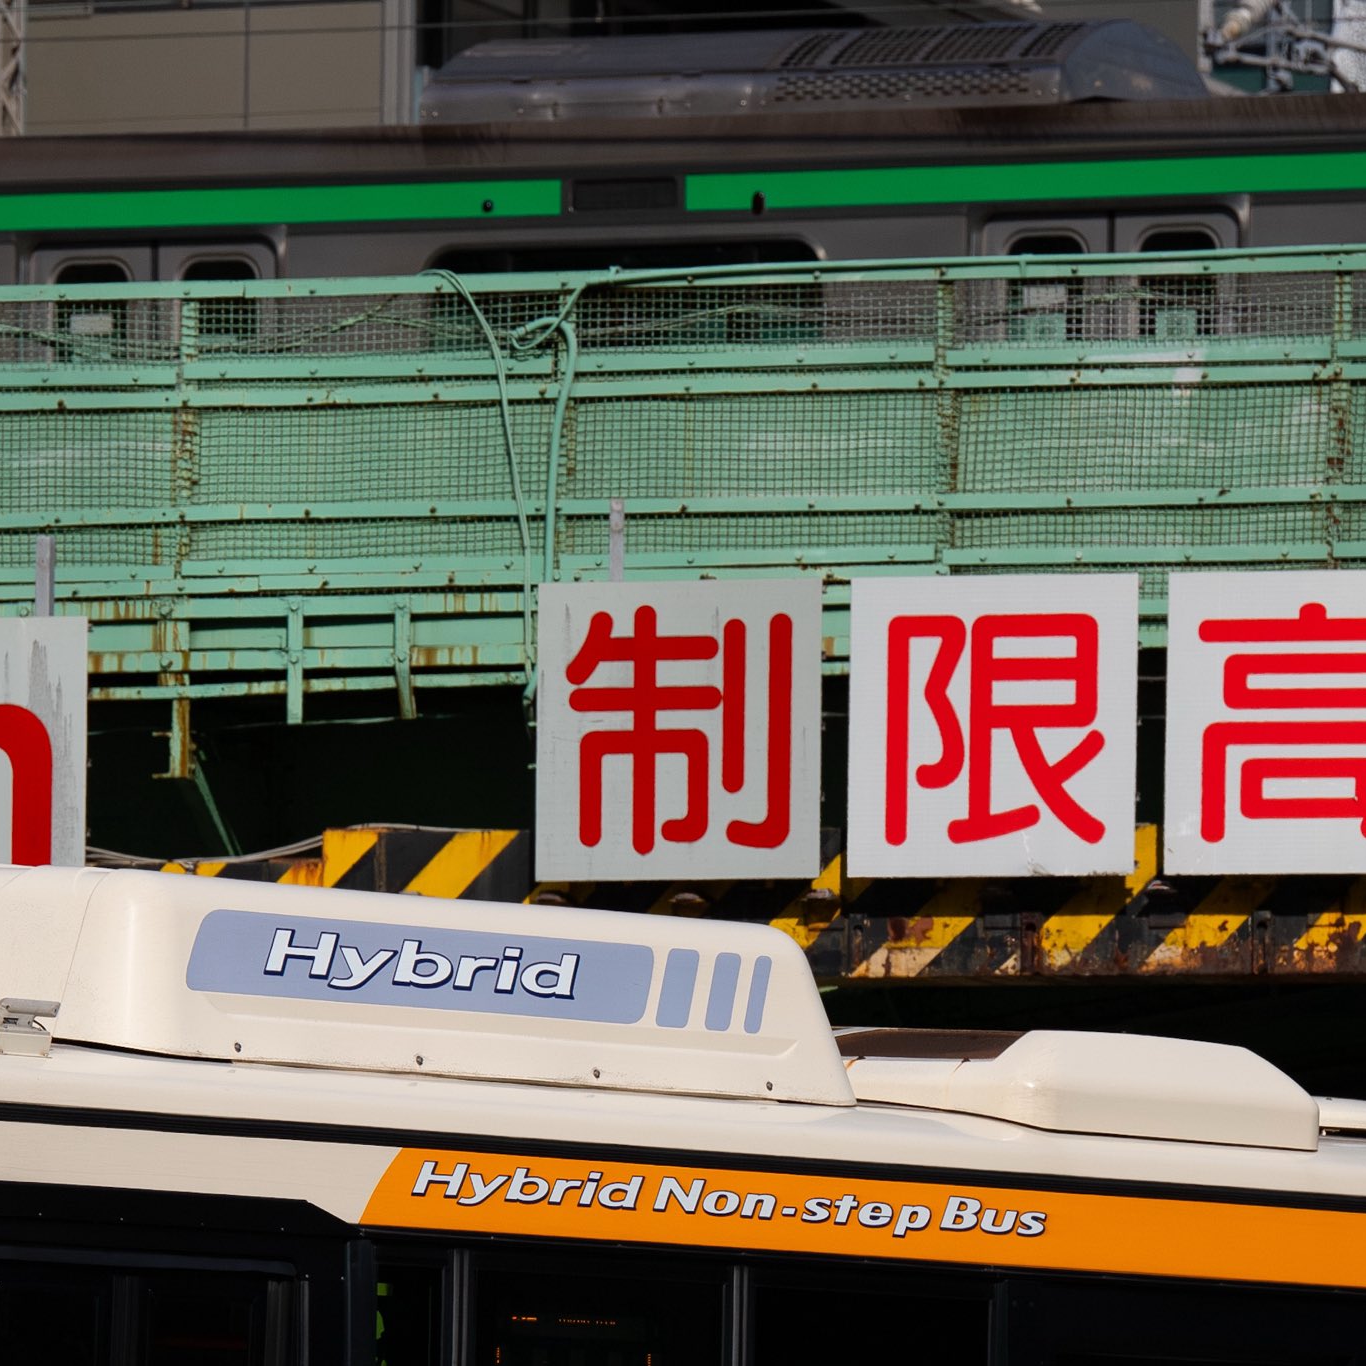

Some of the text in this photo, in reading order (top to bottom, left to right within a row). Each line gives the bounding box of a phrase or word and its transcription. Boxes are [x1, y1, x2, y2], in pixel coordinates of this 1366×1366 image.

[262, 927, 580, 1000] Hybrid
[410, 1159, 1048, 1238] Hybrid Non-step Bus
